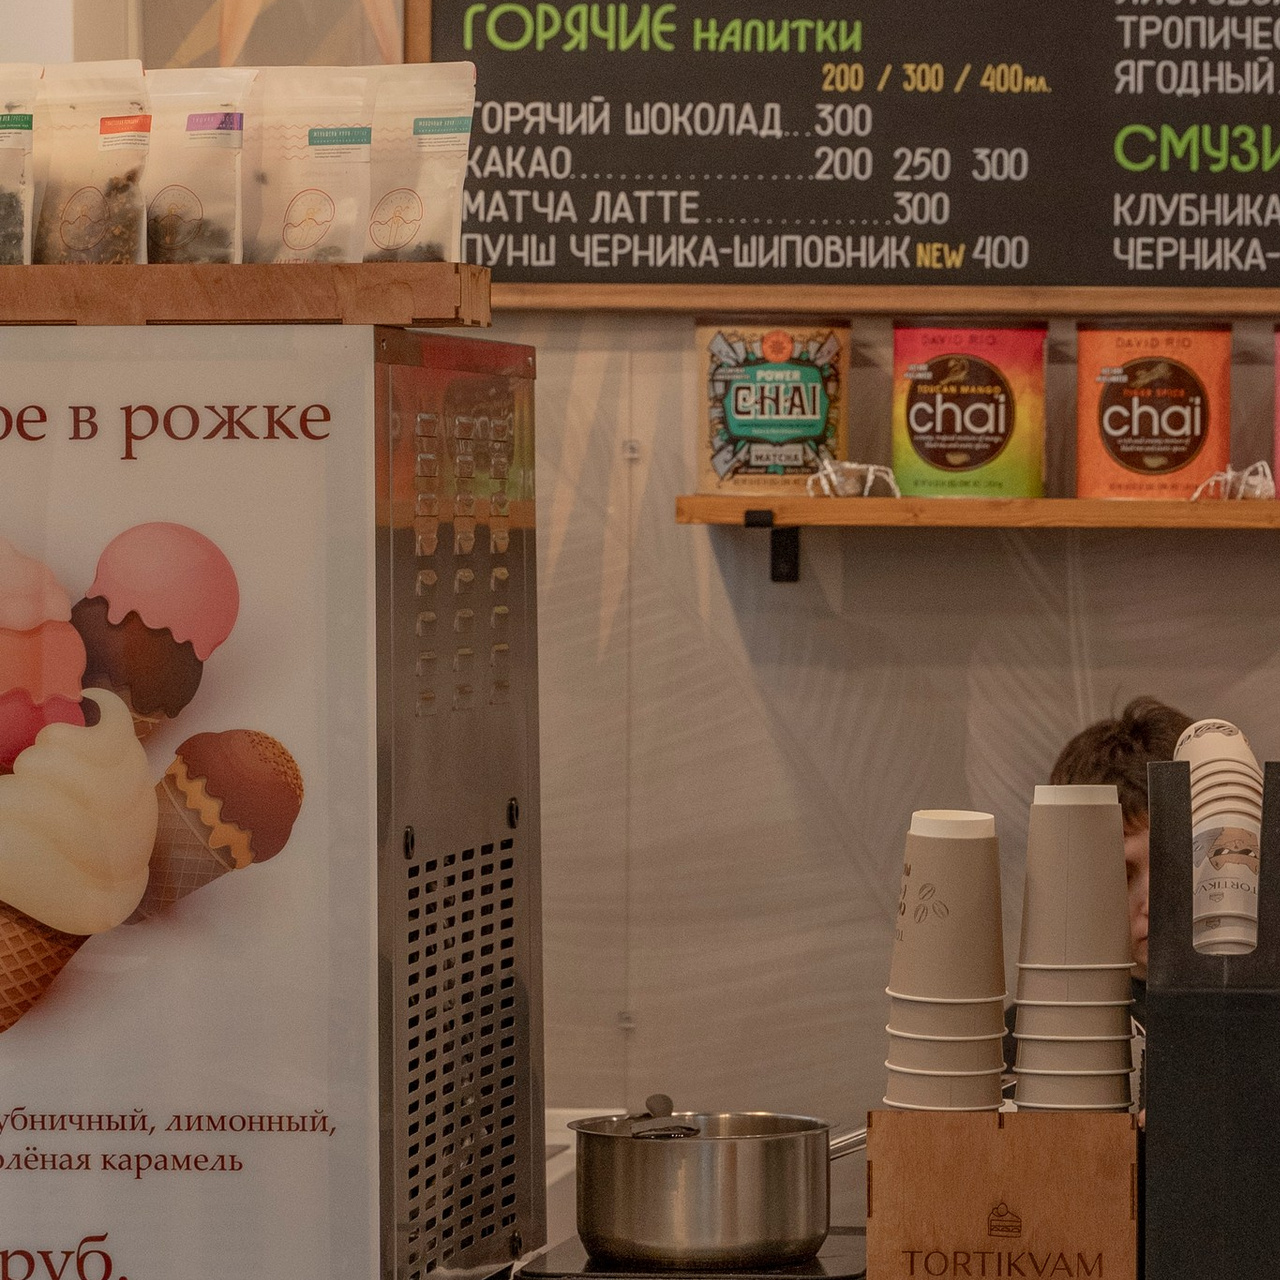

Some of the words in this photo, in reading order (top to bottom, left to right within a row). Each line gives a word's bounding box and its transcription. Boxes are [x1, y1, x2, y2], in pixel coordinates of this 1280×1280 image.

[464, 4, 675, 51] ГОРЯЧИЕ
[1115, 56, 1274, 97] ЯГОДНЫЙ
[474, 96, 610, 135] ОРЯЧИЙ
[625, 102, 783, 138] ШОКОЛАД
[815, 104, 872, 136] 300
[815, 146, 872, 180] 200
[894, 147, 951, 181] 250
[972, 148, 1028, 181] 300
[463, 189, 577, 223] МАТЧА
[590, 190, 699, 224] ЛАТТЕ
[894, 192, 950, 224] 300
[462, 233, 556, 267] ПУНШ
[570, 234, 910, 268] ЧЕРНИКА-ШИПОВНИК
[972, 236, 1029, 268] 400
[733, 383, 821, 420] CHAI
[68, 405, 98, 440] в
[120, 404, 331, 460] рожке
[165, 1109, 337, 1136] лимонный,
[101, 1152, 243, 1179] карамель
[902, 1251, 1103, 1278] TORTIKVAM
